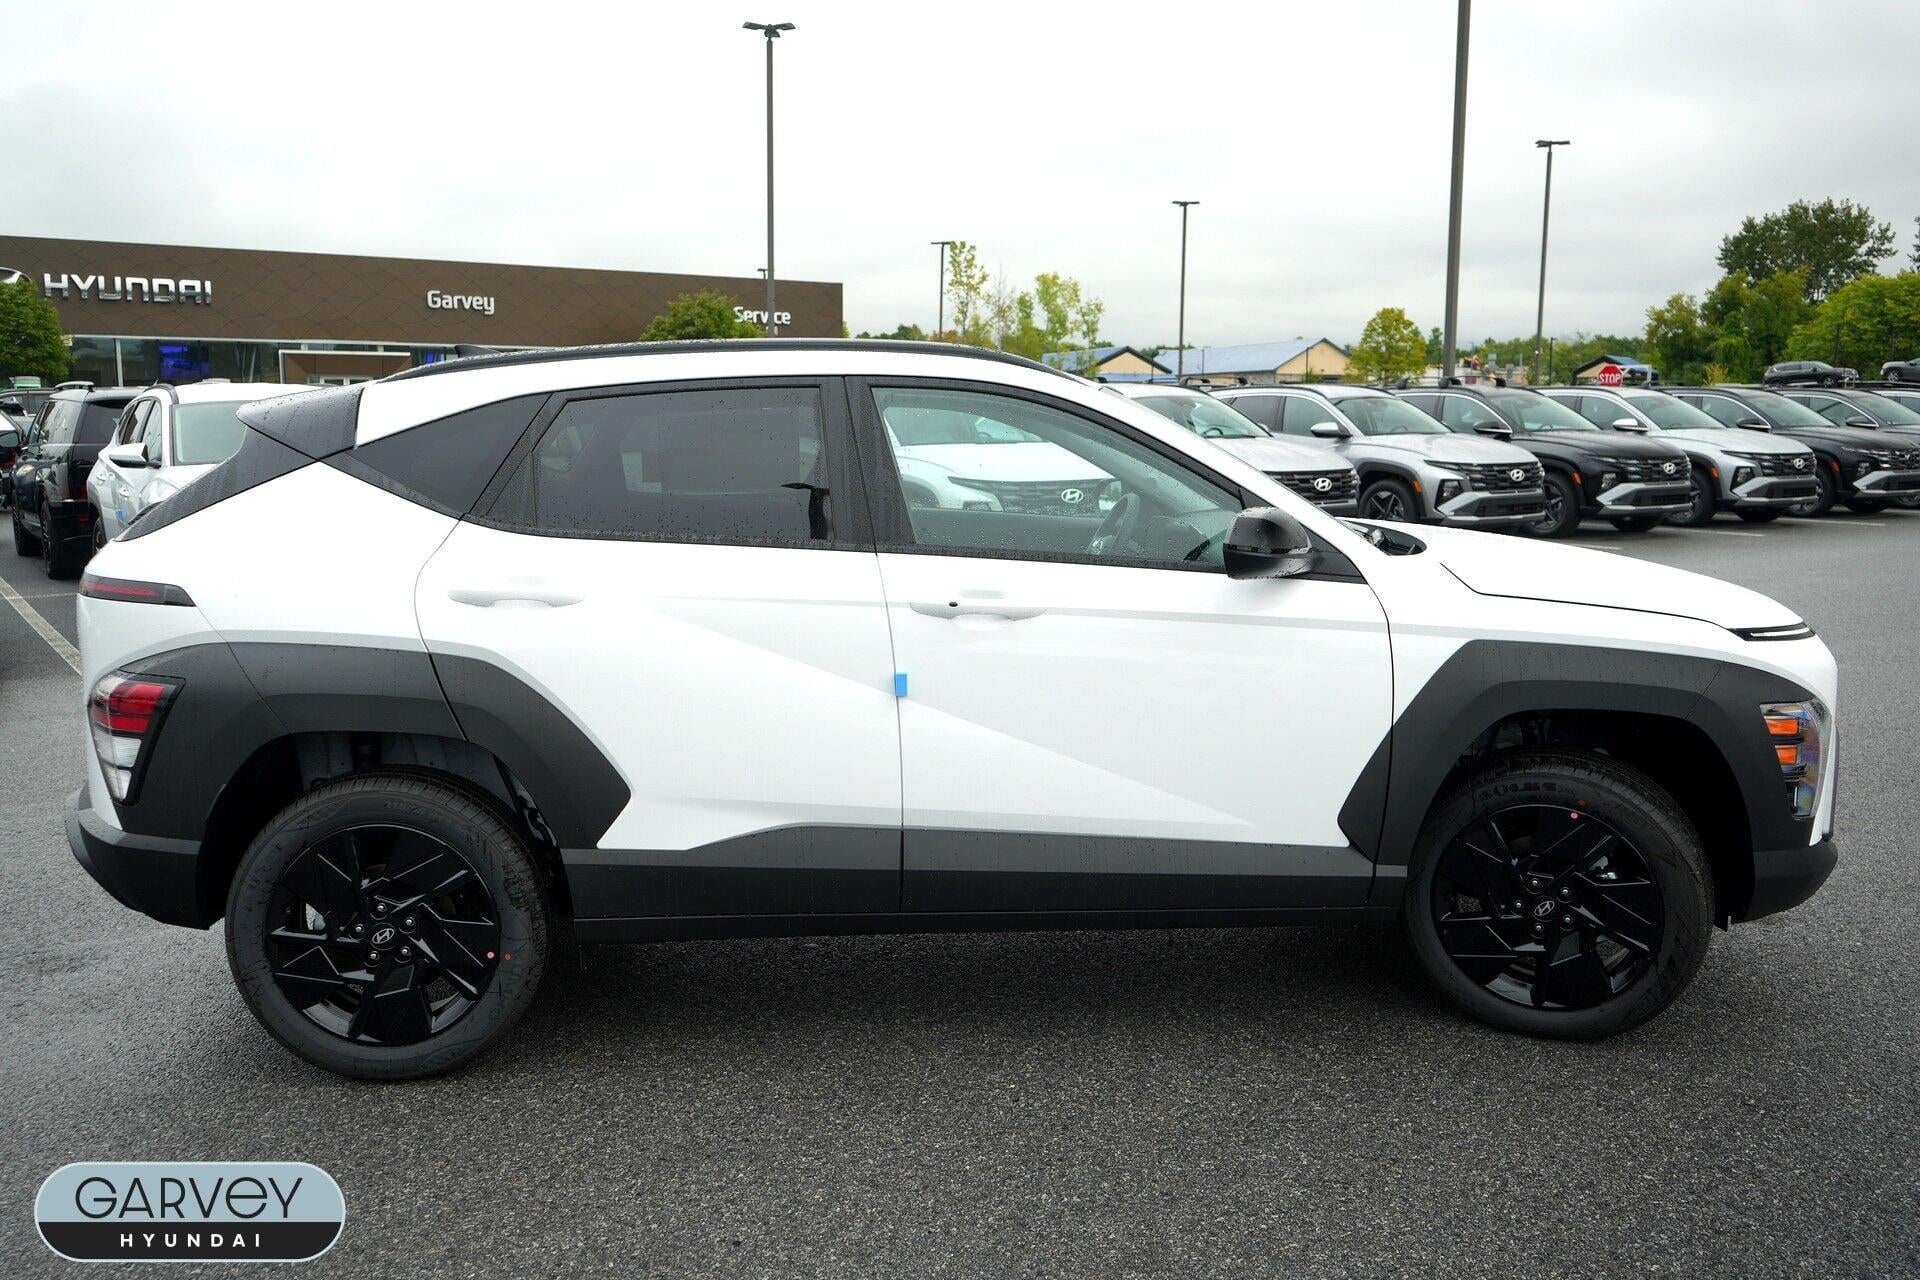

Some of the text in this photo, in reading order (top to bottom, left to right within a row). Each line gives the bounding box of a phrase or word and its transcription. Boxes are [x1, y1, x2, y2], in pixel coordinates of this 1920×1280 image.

[43, 273, 212, 305] HYUNDAI
[427, 290, 495, 315] Garvey
[733, 306, 791, 325] Servce
[1600, 373, 1621, 384] STOP
